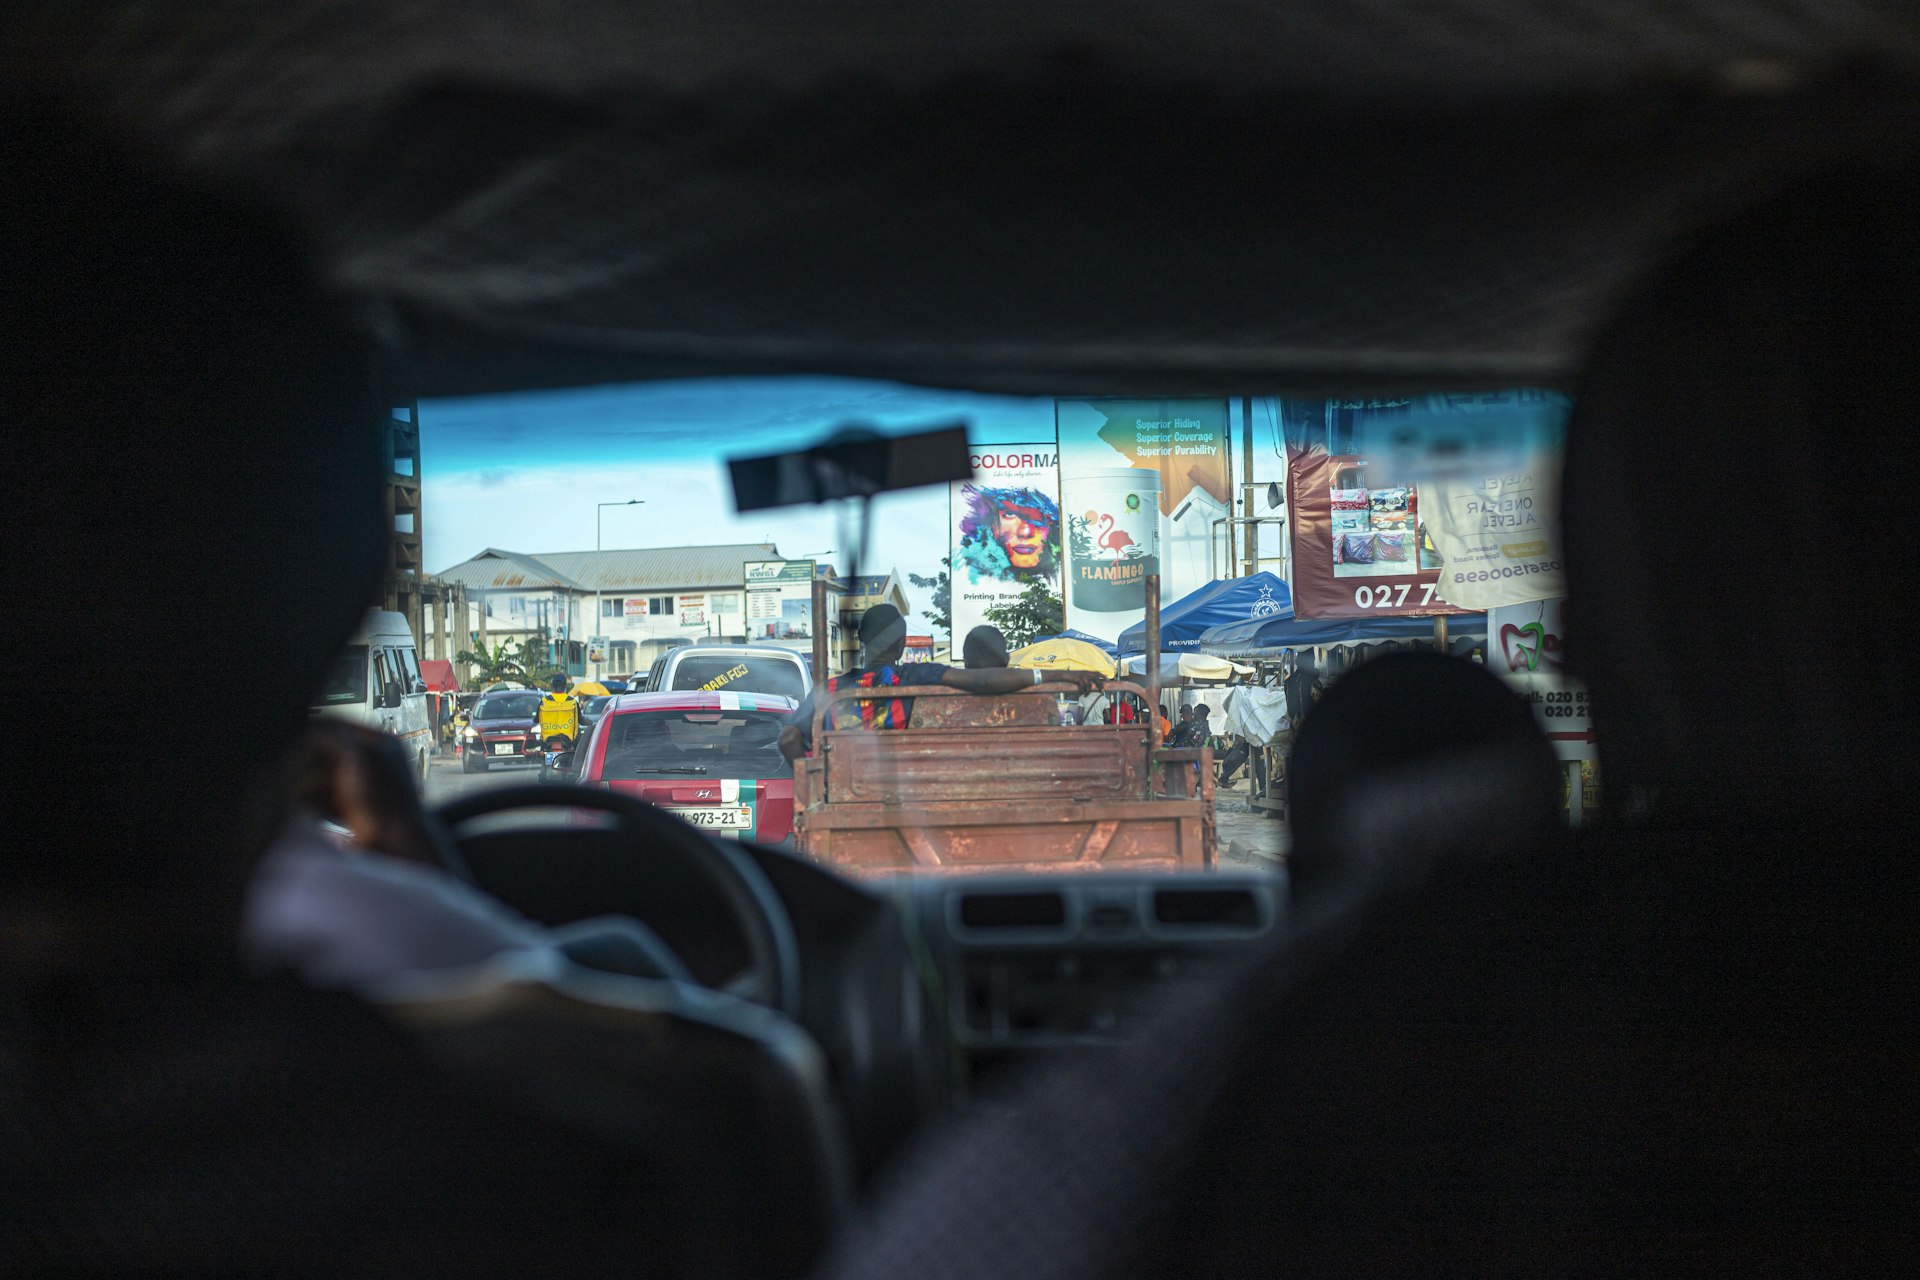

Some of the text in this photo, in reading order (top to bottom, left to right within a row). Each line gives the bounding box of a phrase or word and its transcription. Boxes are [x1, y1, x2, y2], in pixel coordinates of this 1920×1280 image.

[1136, 418, 1200, 431] Superior Hiding
[1136, 432, 1213, 445] Superior Coverage
[1137, 444, 1216, 458] Superior Durability
[1081, 563, 1144, 580] FLAMINGO
[963, 593, 995, 601] Printing
[1354, 584, 1412, 609] 027
[1546, 692, 1573, 703] 020
[1545, 706, 1573, 717] 020
[692, 812, 736, 825] 973-21
